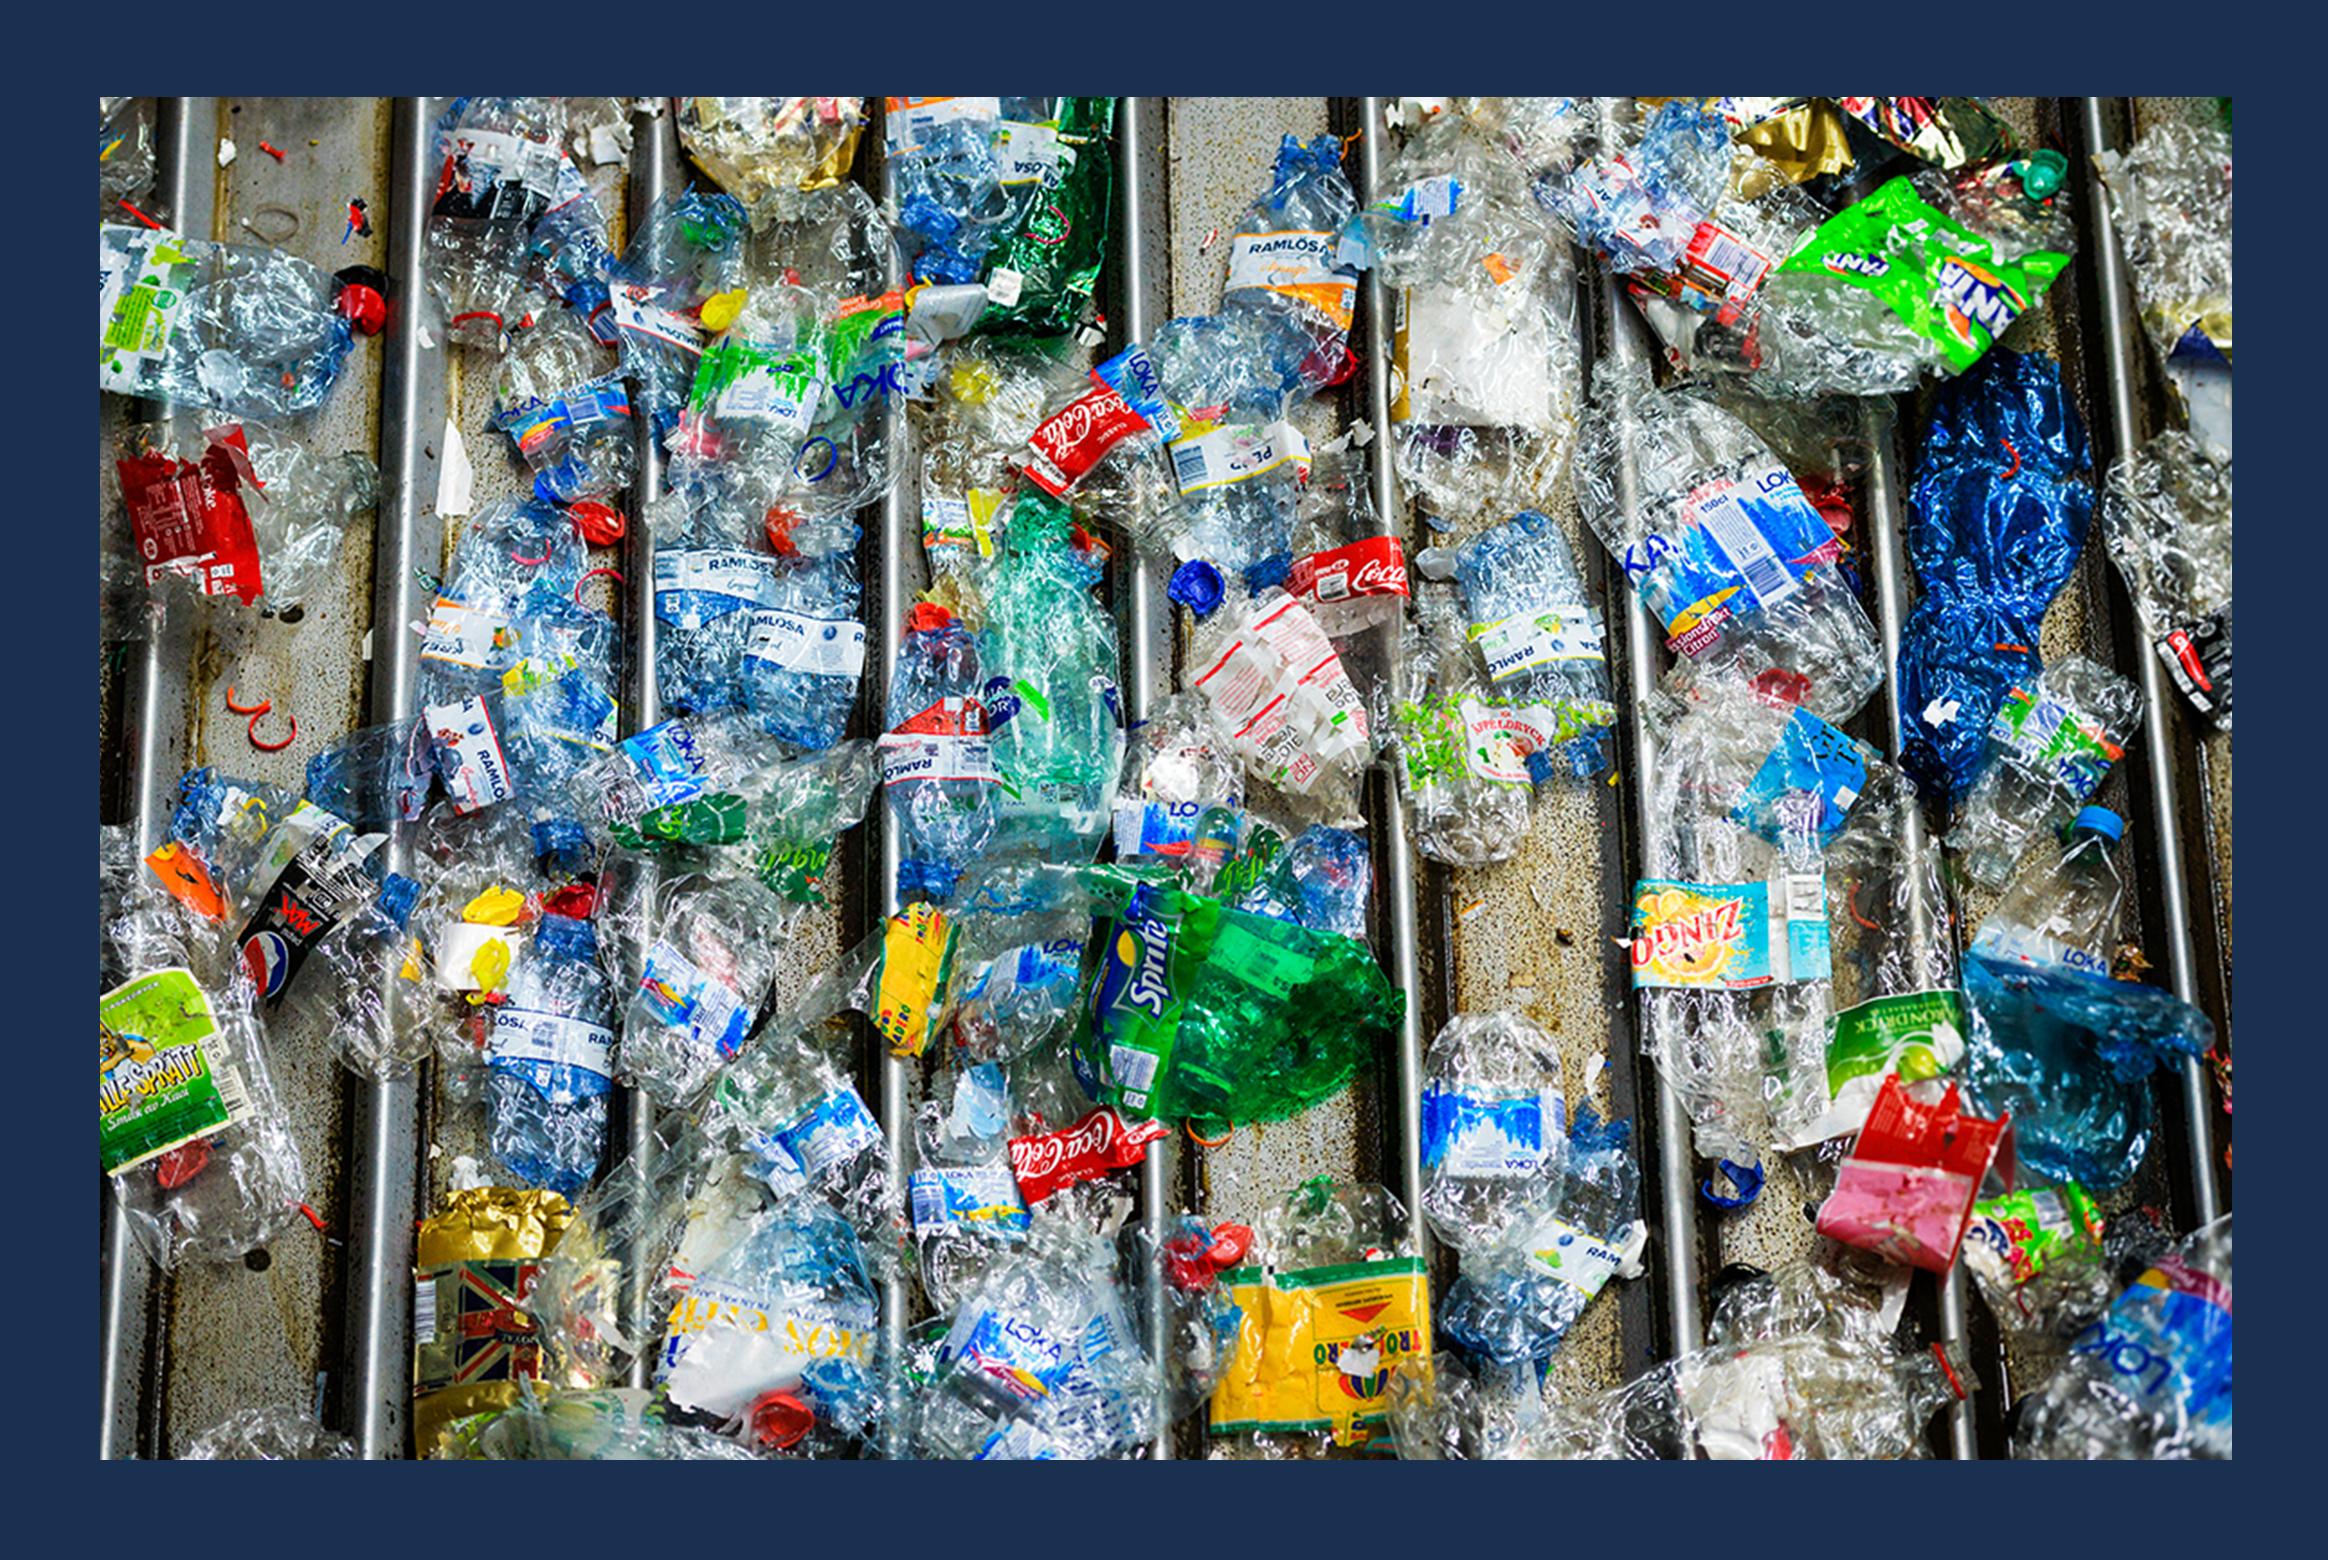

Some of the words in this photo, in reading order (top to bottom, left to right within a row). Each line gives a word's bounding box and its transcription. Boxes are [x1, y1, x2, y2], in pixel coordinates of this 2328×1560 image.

[1128, 350, 1162, 402] LOKA
[1629, 895, 1746, 967] ZINGO
[1129, 915, 1171, 1018] Sprite
[1505, 1159, 1540, 1171] LOKA
